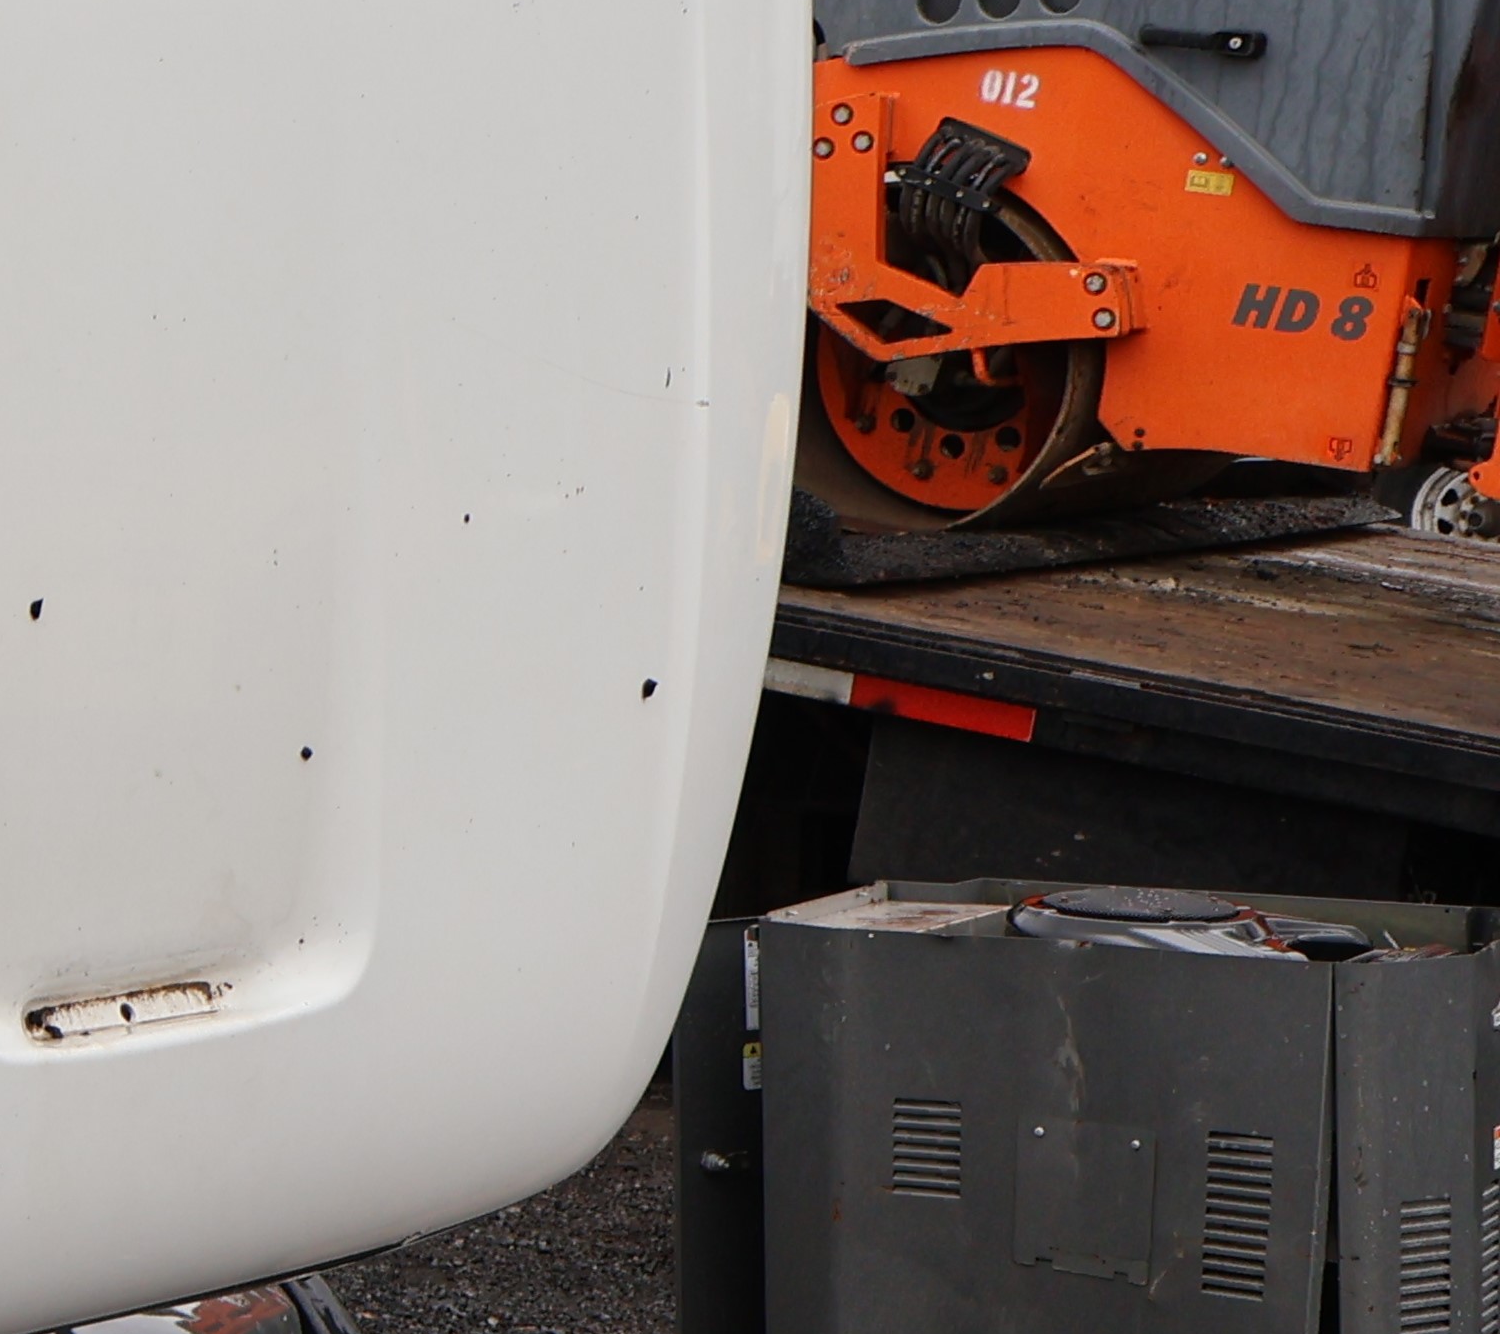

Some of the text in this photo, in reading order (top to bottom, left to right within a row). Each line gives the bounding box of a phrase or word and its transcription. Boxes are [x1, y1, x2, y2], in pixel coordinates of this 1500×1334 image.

[980, 69, 1040, 108] 012
[1231, 283, 1374, 341] HD 8
